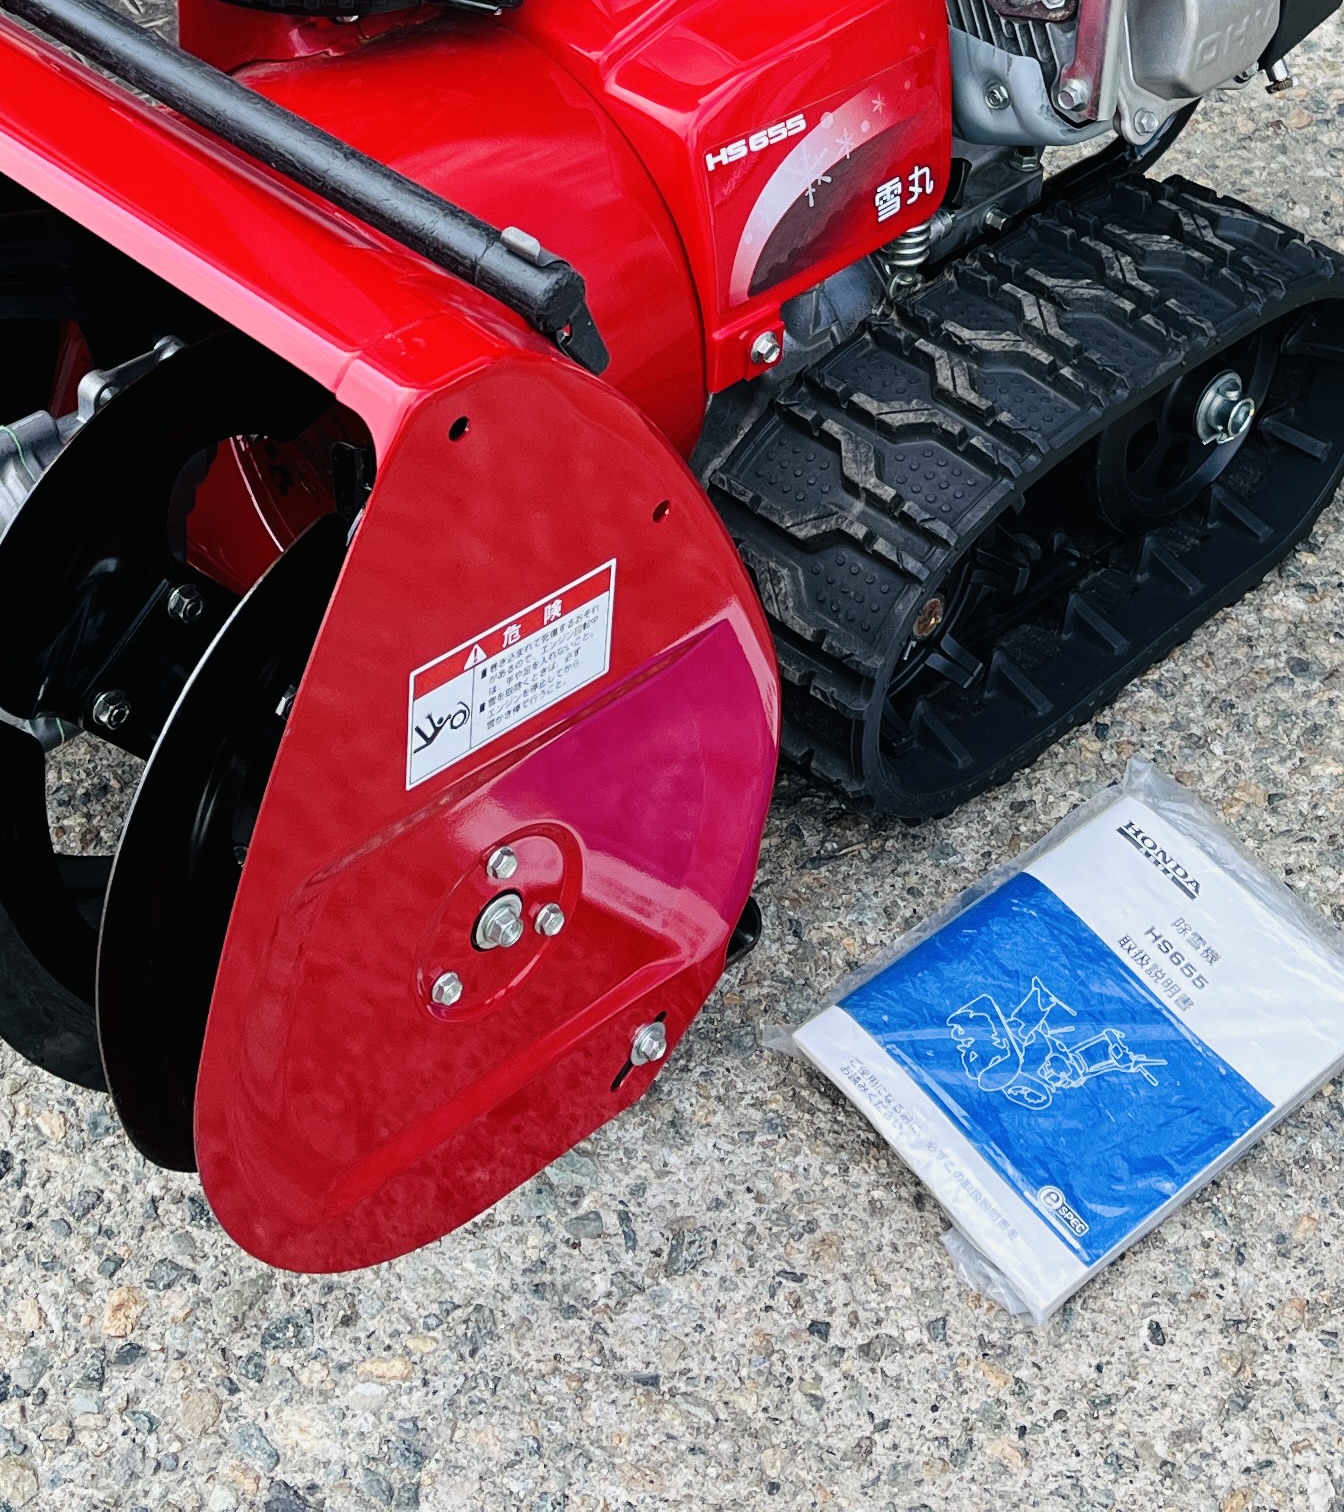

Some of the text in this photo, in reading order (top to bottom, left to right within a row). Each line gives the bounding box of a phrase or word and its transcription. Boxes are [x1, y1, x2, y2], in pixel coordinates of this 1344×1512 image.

[706, 114, 807, 171] HS655
[875, 165, 935, 223] 雪丸
[502, 599, 562, 648] 危険
[1123, 820, 1201, 896] HONDA
[1144, 925, 1209, 990] HS655
[1170, 917, 1222, 966] 除雪機
[1117, 934, 1195, 1012] 取扱説明書
